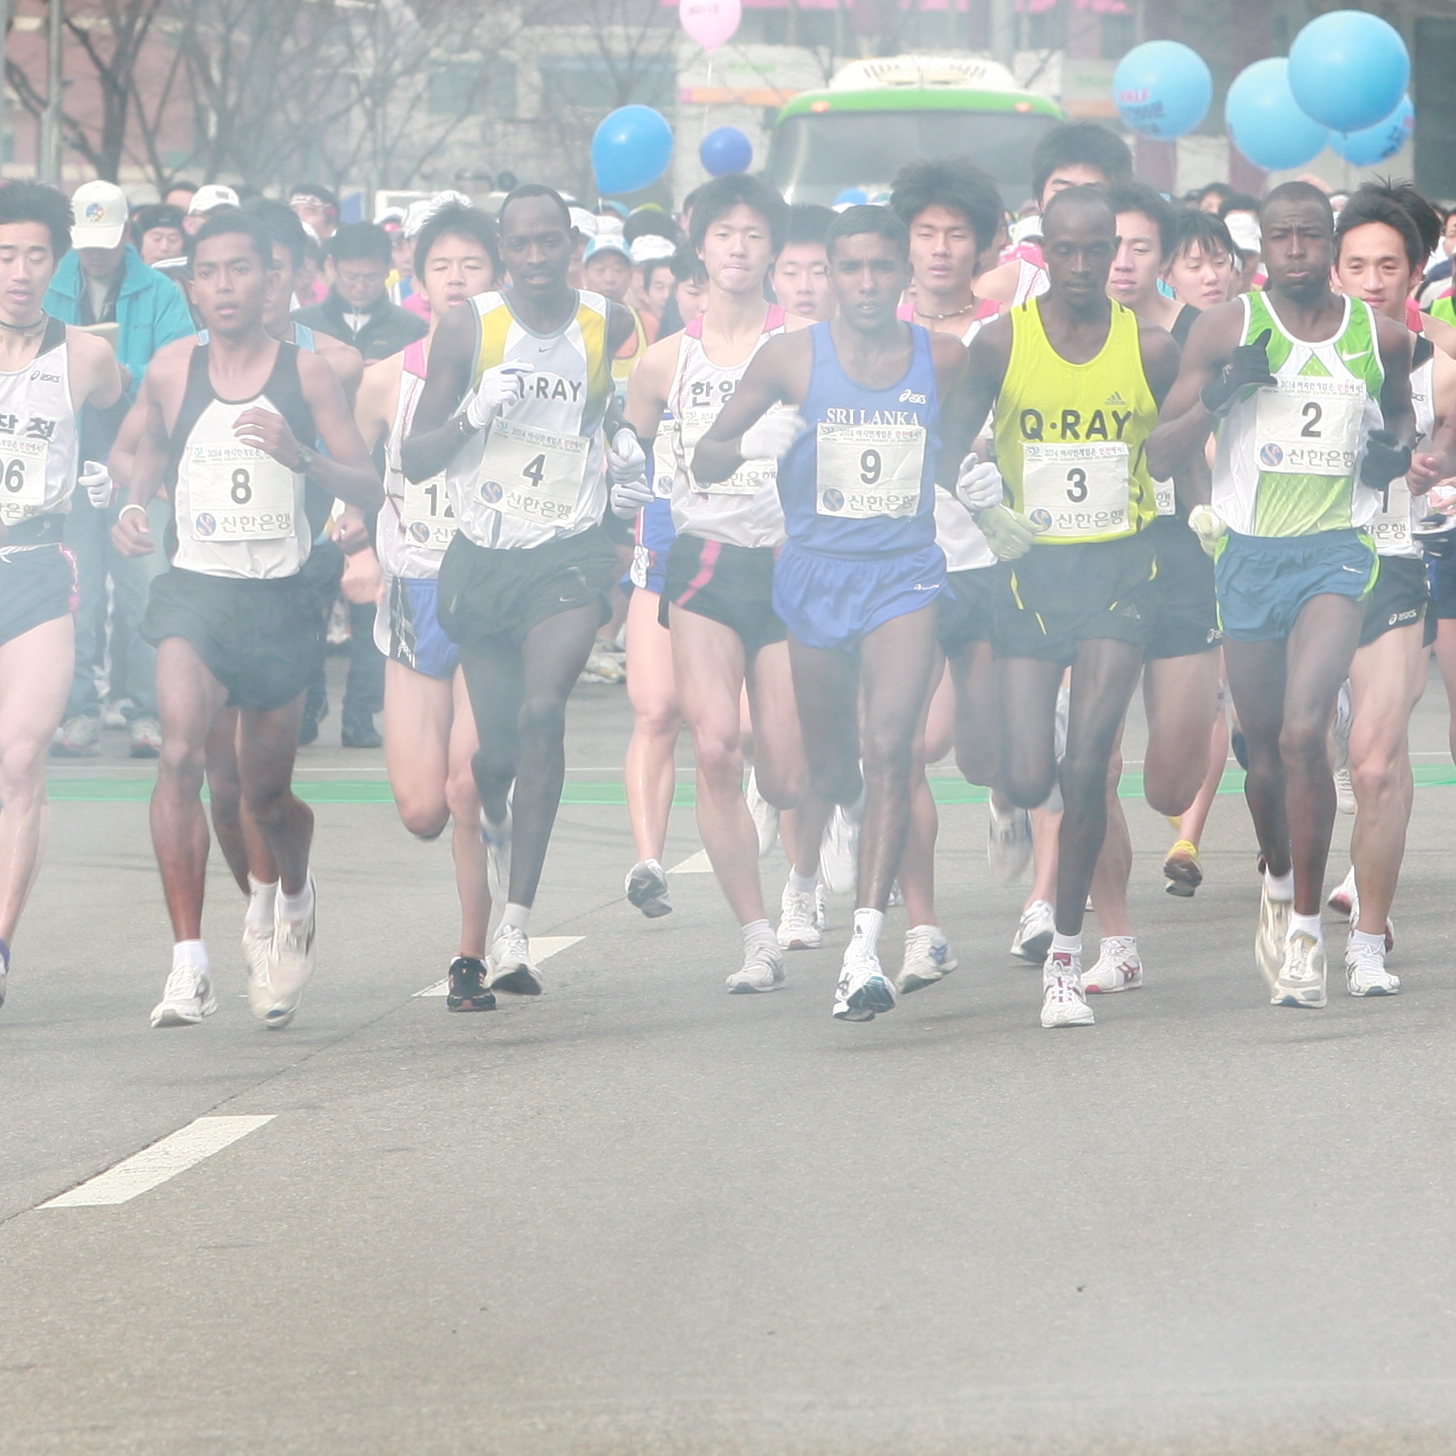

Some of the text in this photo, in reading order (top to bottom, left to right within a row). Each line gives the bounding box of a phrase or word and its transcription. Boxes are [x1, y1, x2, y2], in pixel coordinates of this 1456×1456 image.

[827, 408, 920, 426] SRI LANKA
[1301, 402, 1322, 438] 2
[522, 454, 546, 487] 4
[860, 449, 882, 485] 9
[1285, 448, 1355, 469] 신한은행
[231, 468, 252, 504] 8
[1066, 468, 1088, 503] 3
[507, 491, 573, 520] 신한은행
[1056, 509, 1125, 530] 신한은행
[220, 513, 291, 533] 신한은행
